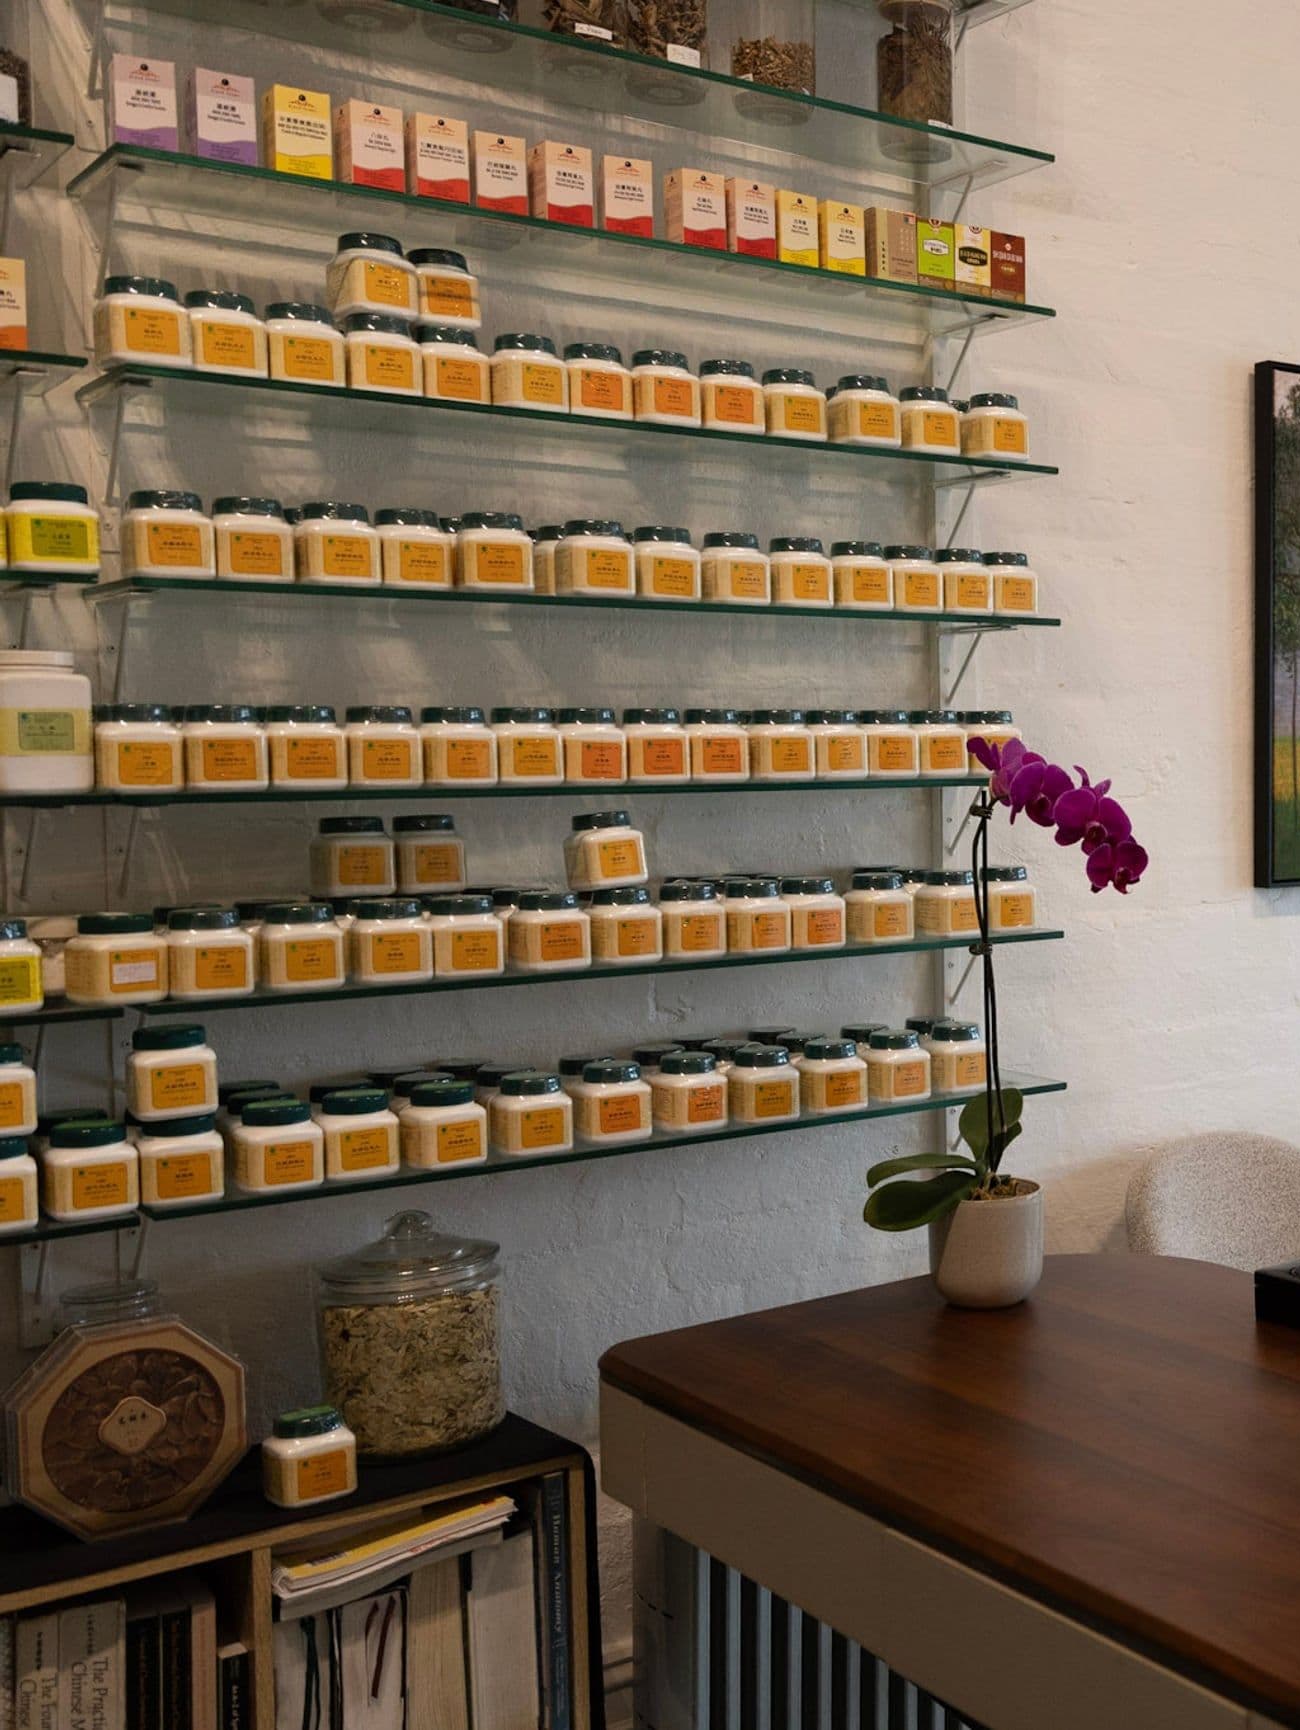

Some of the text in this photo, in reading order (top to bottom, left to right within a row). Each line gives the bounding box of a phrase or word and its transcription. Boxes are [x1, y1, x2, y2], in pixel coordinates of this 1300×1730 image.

[554, 1573, 563, 1633] Anatomy
[71, 1662, 88, 1714] Chinese
[93, 1657, 108, 1683] The
